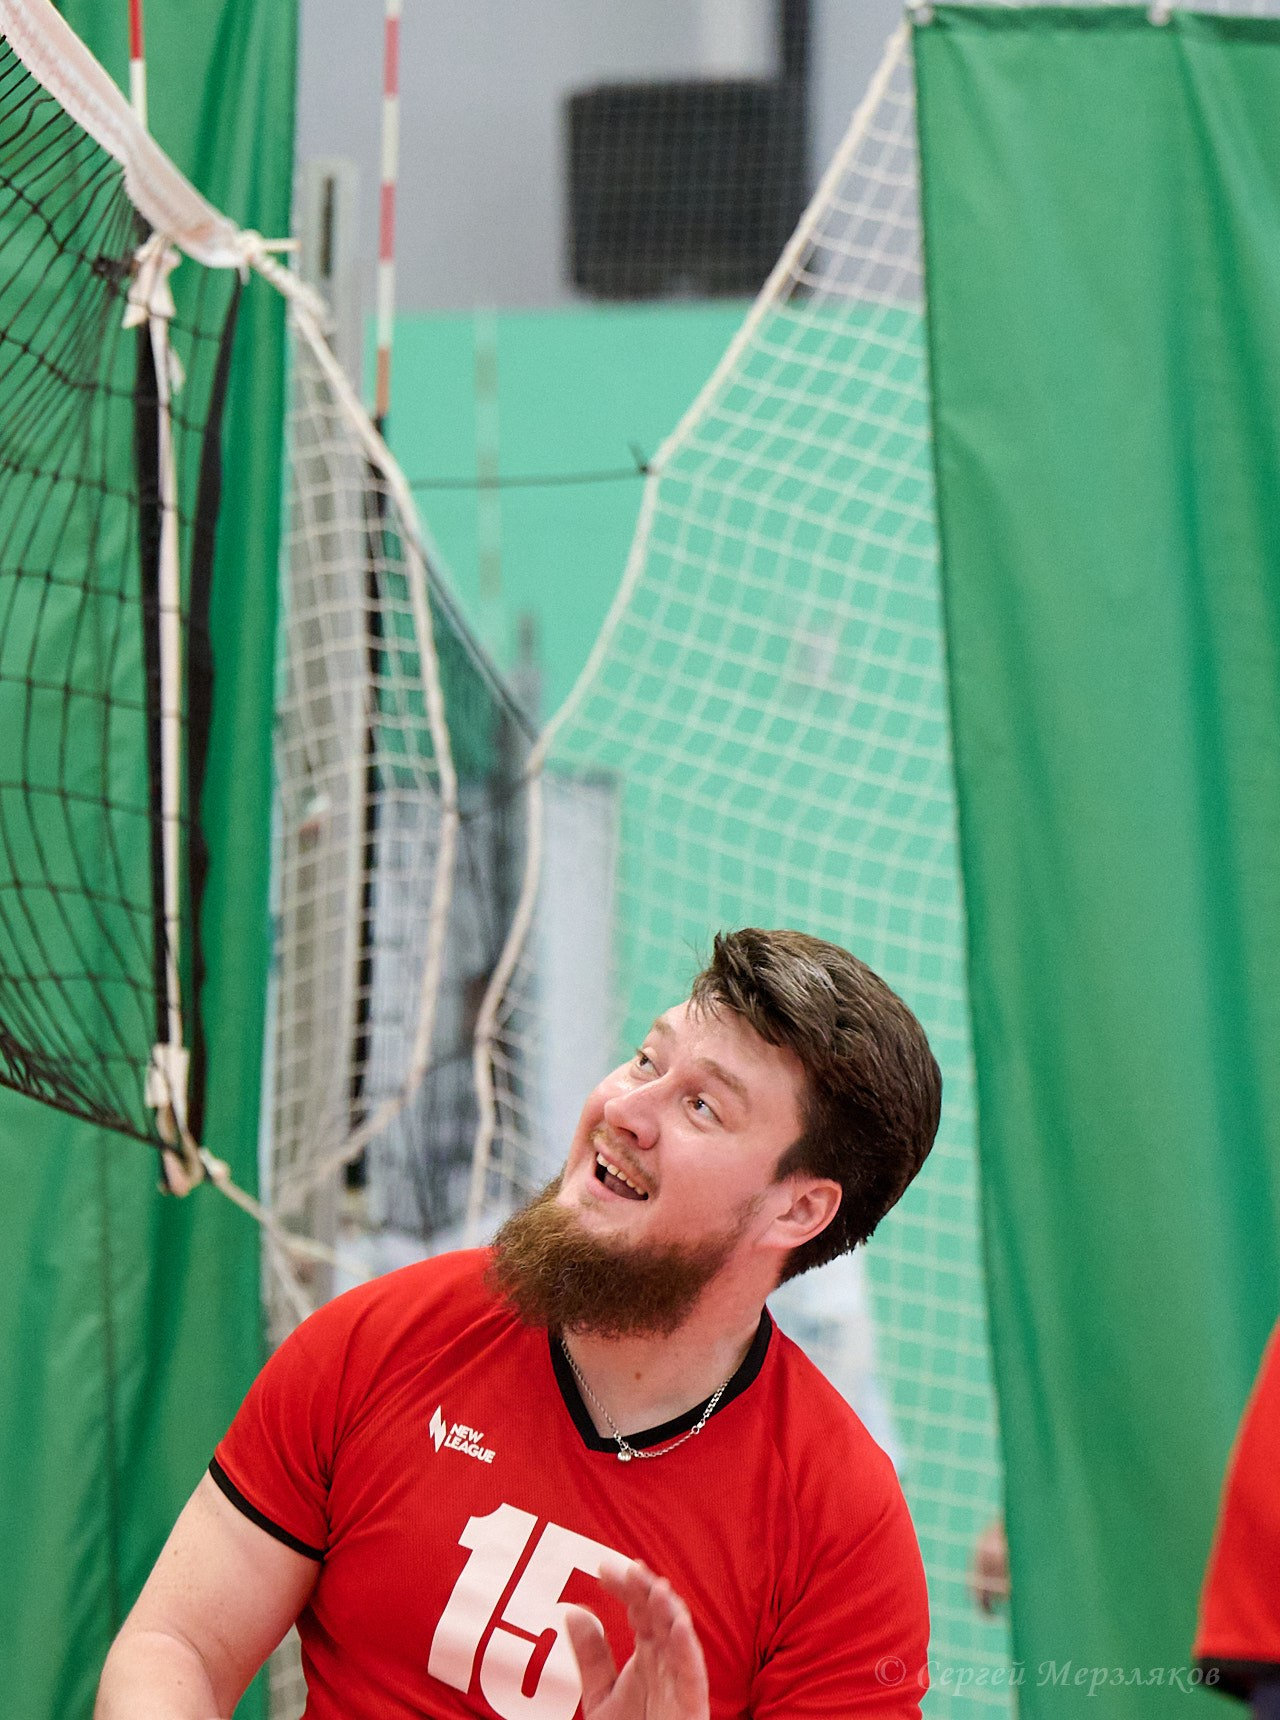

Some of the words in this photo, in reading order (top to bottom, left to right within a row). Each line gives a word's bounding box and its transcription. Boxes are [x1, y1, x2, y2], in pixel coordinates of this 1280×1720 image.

[449, 1422, 485, 1444] NEW
[443, 1434, 496, 1464] LEAGUE
[427, 1502, 641, 1720] 15
